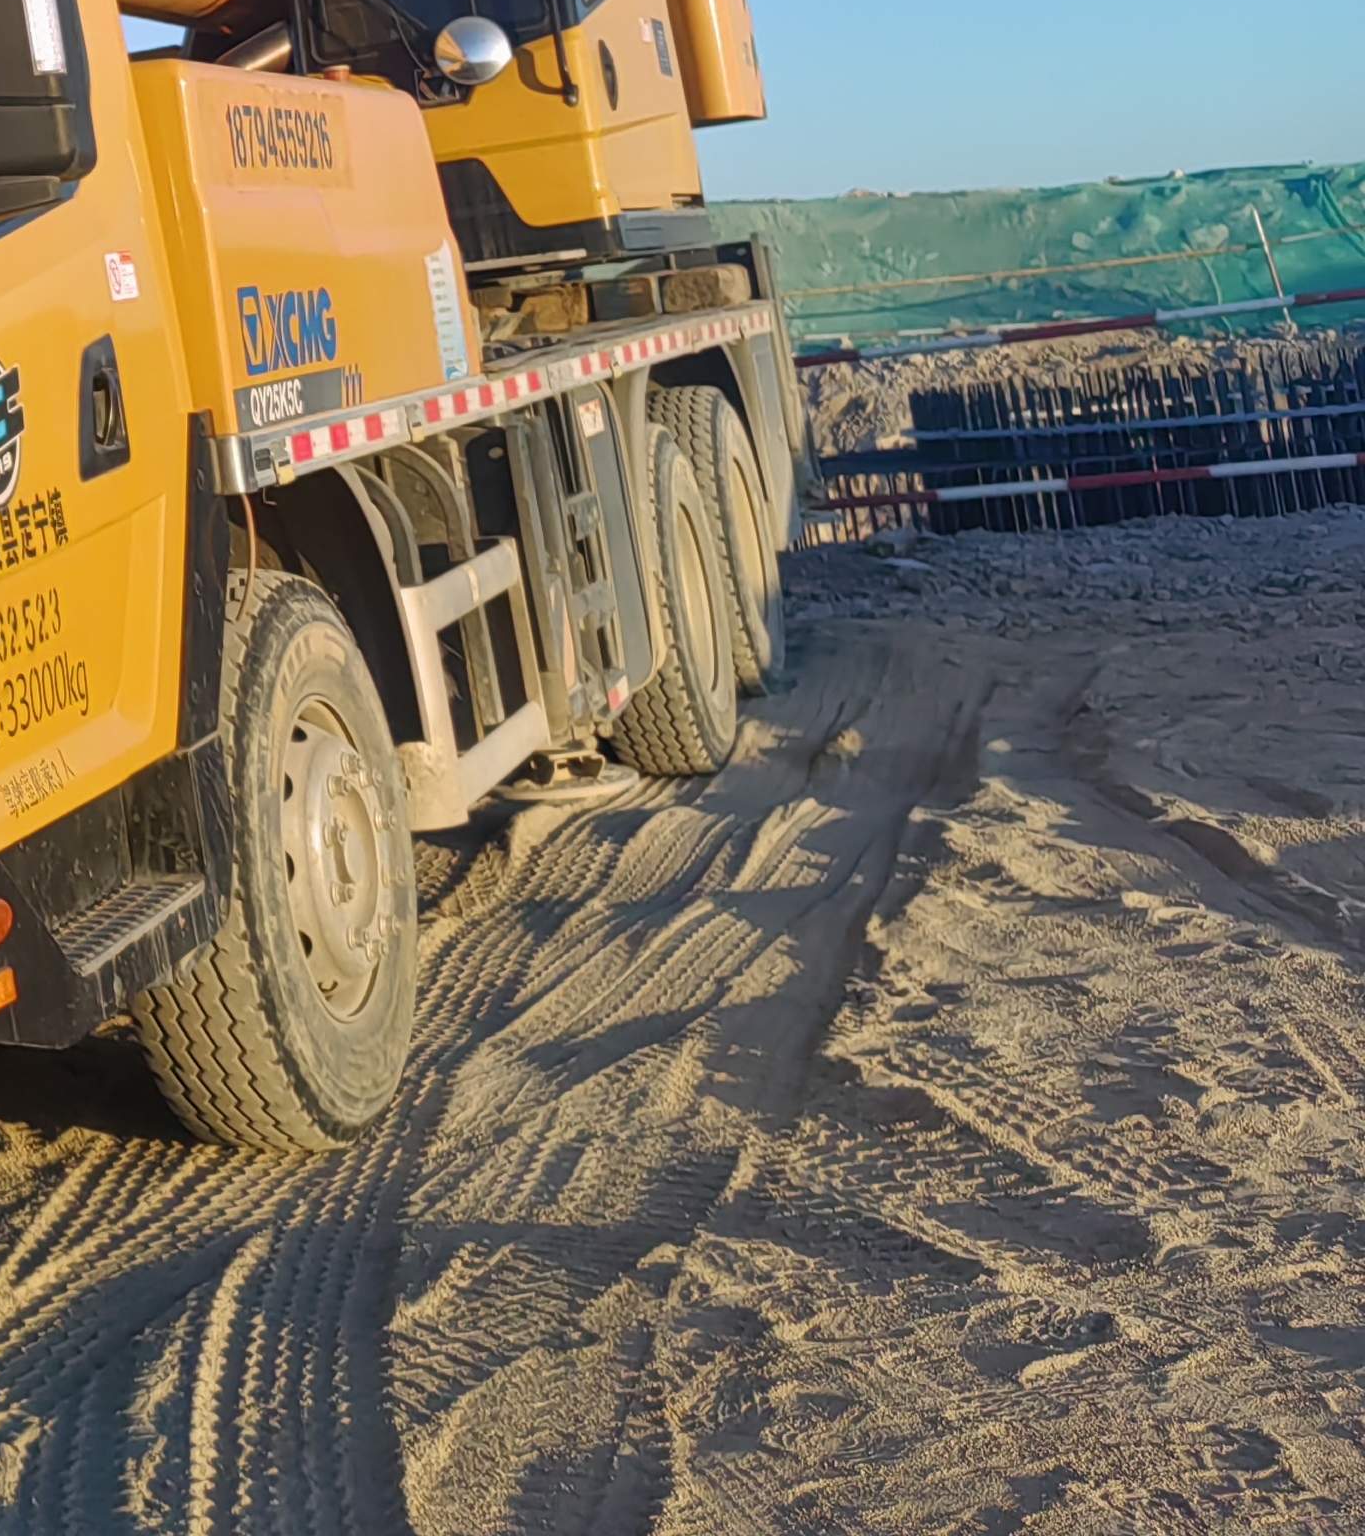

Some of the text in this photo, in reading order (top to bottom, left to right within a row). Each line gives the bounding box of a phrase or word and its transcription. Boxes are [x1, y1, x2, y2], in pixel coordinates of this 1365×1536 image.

[225, 103, 333, 170] 18794559216
[264, 286, 337, 371] XCMG
[250, 378, 304, 427] QY25K5C
